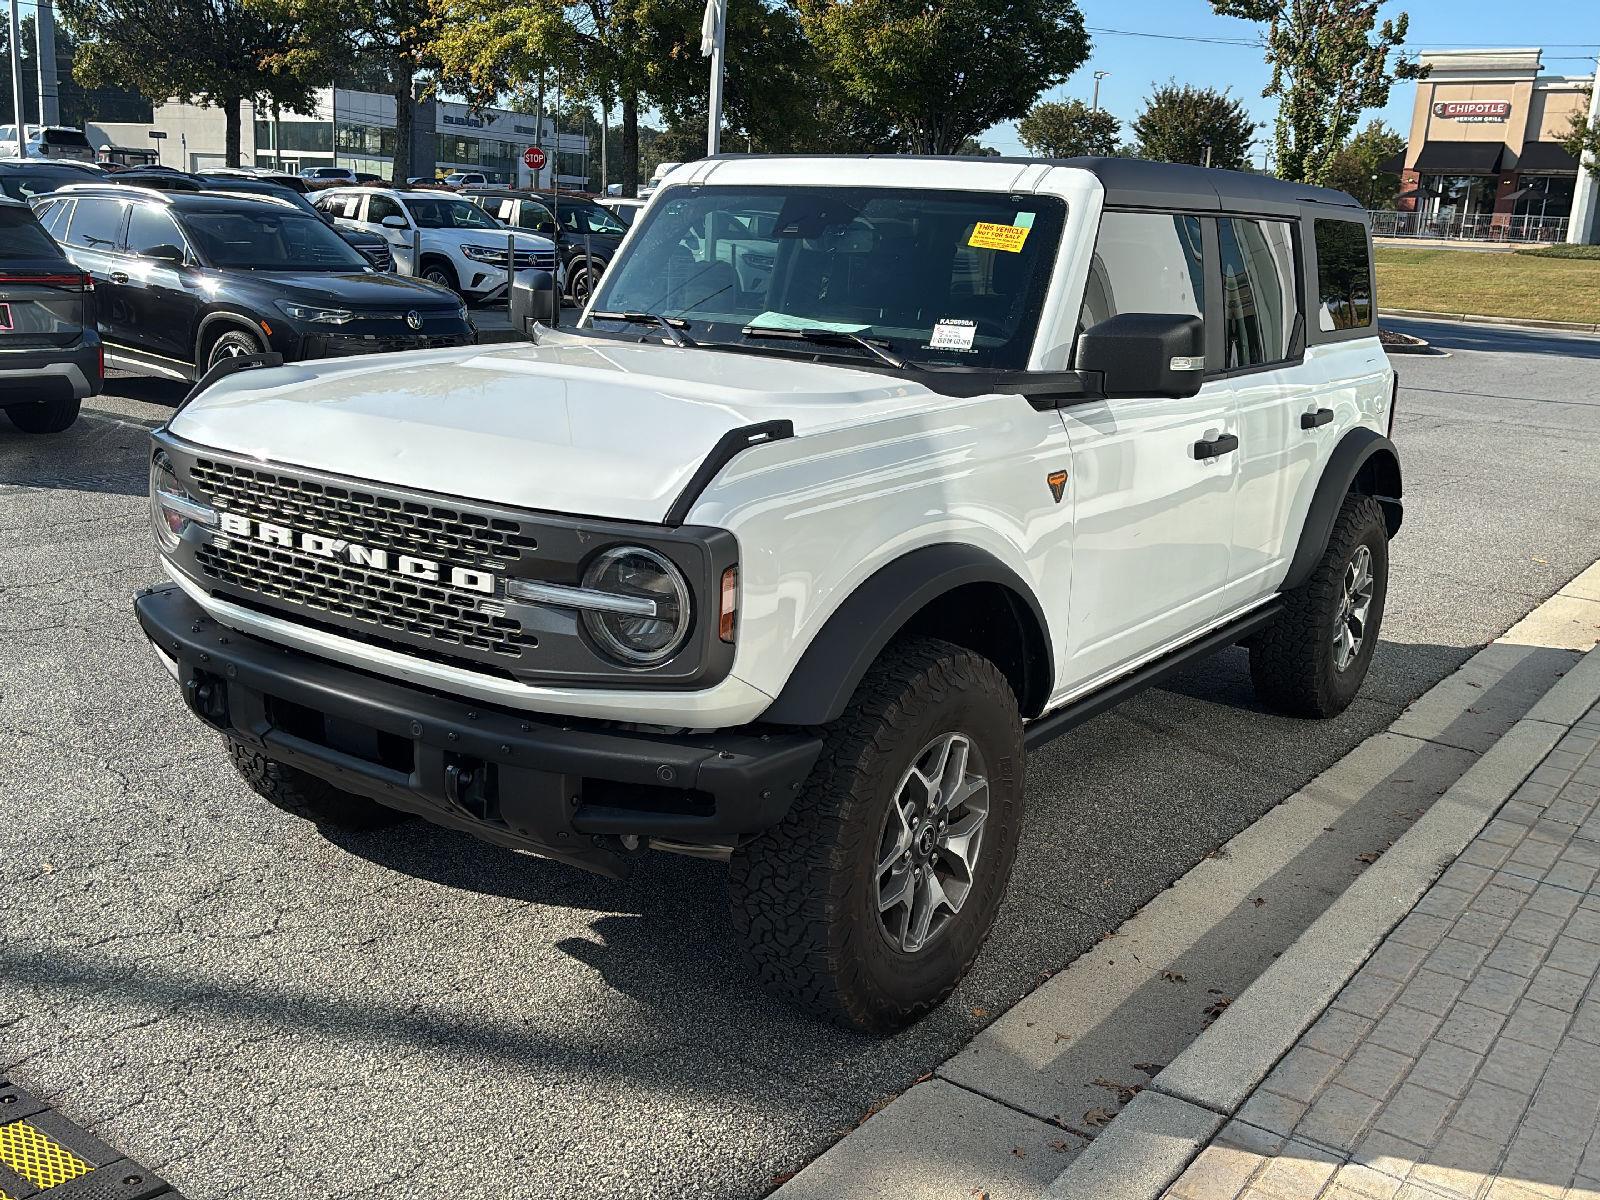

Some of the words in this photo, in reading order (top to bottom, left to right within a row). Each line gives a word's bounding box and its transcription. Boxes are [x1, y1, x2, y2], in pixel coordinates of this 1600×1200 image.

[1448, 104, 1505, 113] CHIPOTLE
[525, 153, 544, 163] STOP
[996, 226, 1025, 235] VEHICLE
[220, 512, 495, 594] BRONCO
